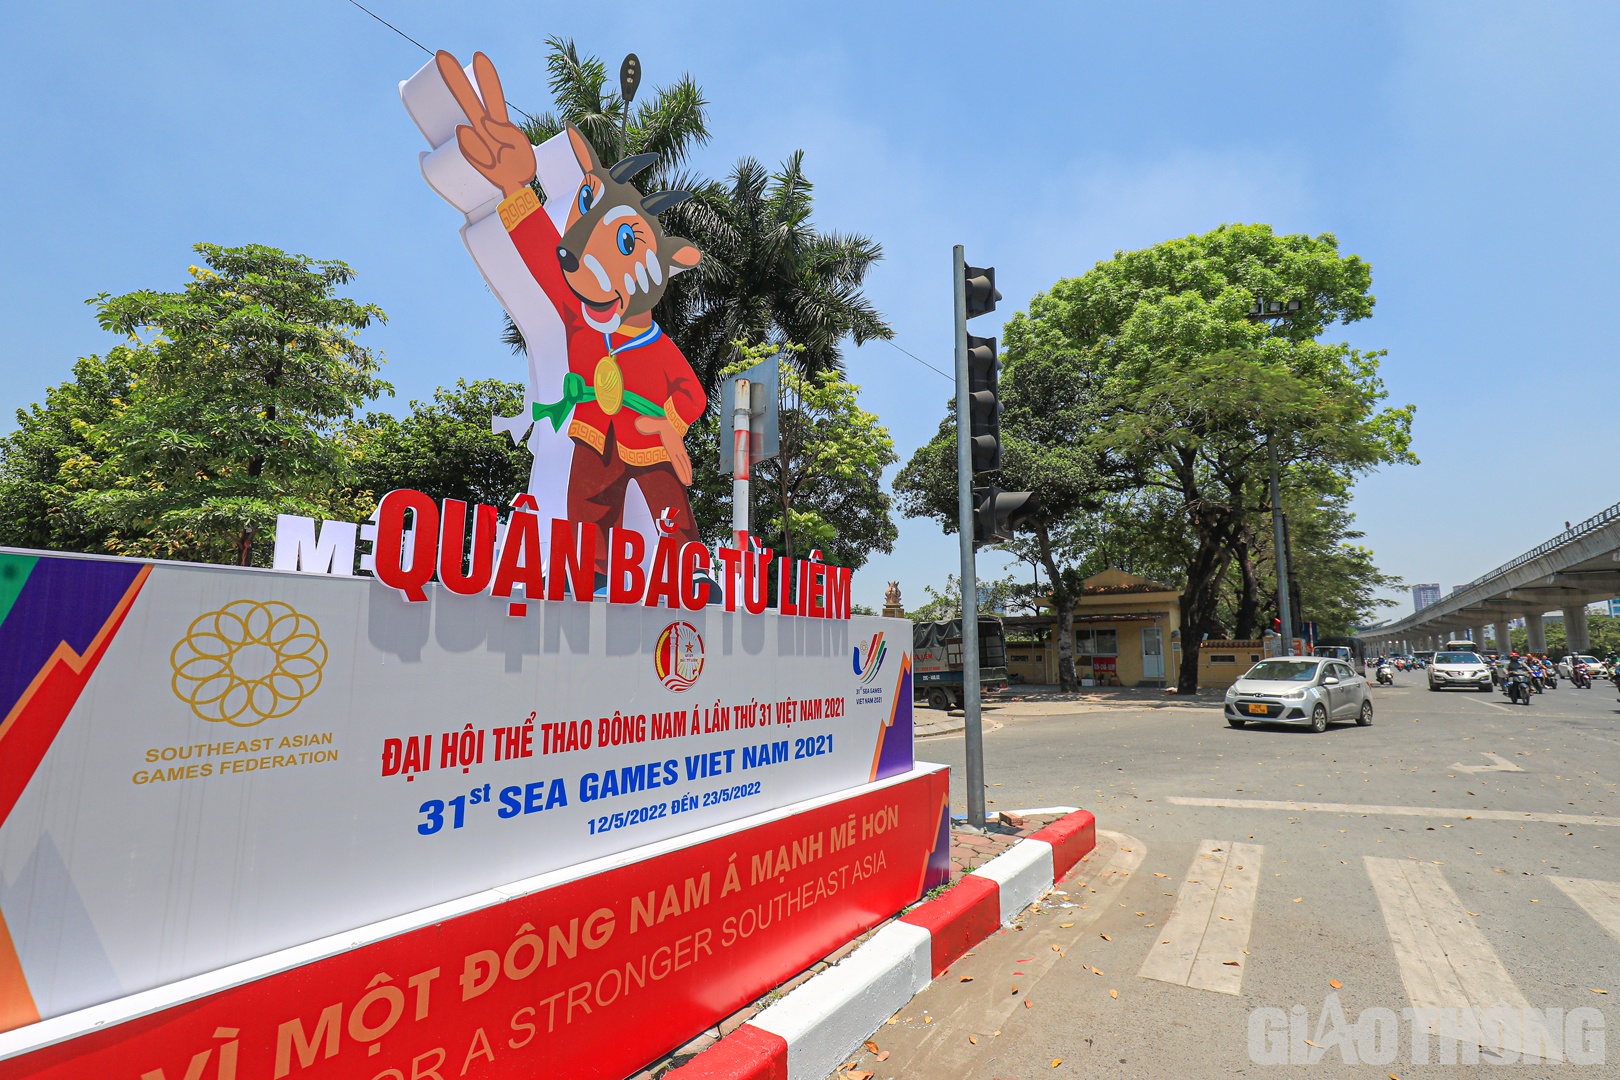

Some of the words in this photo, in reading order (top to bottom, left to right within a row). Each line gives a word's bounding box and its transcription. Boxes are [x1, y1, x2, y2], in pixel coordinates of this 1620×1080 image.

[373, 488, 597, 617] QUẬN
[607, 506, 711, 613] BẮC
[718, 535, 774, 615] TỪ
[778, 549, 852, 620] LIÊM
[131, 763, 213, 785] GAMES
[219, 749, 339, 775] FEDERATION
[145, 737, 274, 763] SOUTHEAST
[278, 732, 333, 750] ASIAN
[381, 735, 432, 782] ĐẠI
[440, 723, 485, 774] HỘI
[492, 711, 537, 762] THỂ
[541, 719, 593, 755] THAO
[597, 711, 646, 748] ĐÔNG
[651, 711, 687, 741] NAM
[690, 704, 701, 736] Á
[704, 699, 730, 734] LẦN
[733, 698, 758, 731] THỨ
[759, 703, 772, 727] 31
[776, 697, 798, 729] VIỆT
[800, 699, 823, 722] NAM
[824, 697, 845, 719] 2021
[497, 778, 568, 819] SEA
[579, 759, 678, 803] GAMES
[685, 749, 735, 781] VIET
[742, 741, 789, 770] NAM
[794, 734, 833, 759] 2021
[587, 804, 667, 835] 12/5/2022
[671, 792, 699, 815] ĐẾN
[702, 781, 761, 807] 23/5/2022
[274, 966, 440, 1080] MỘT
[459, 907, 616, 1002] ĐÔNG
[630, 871, 711, 934] NAM
[720, 857, 741, 899] Á
[751, 831, 824, 885] MẠNH
[830, 814, 858, 853] MẼ
[861, 804, 899, 844] HƠN
[460, 1027, 495, 1077] A
[508, 928, 713, 1048] STRONGER
[721, 865, 850, 948] SOUTHEAST
[851, 849, 887, 892] ASIA
